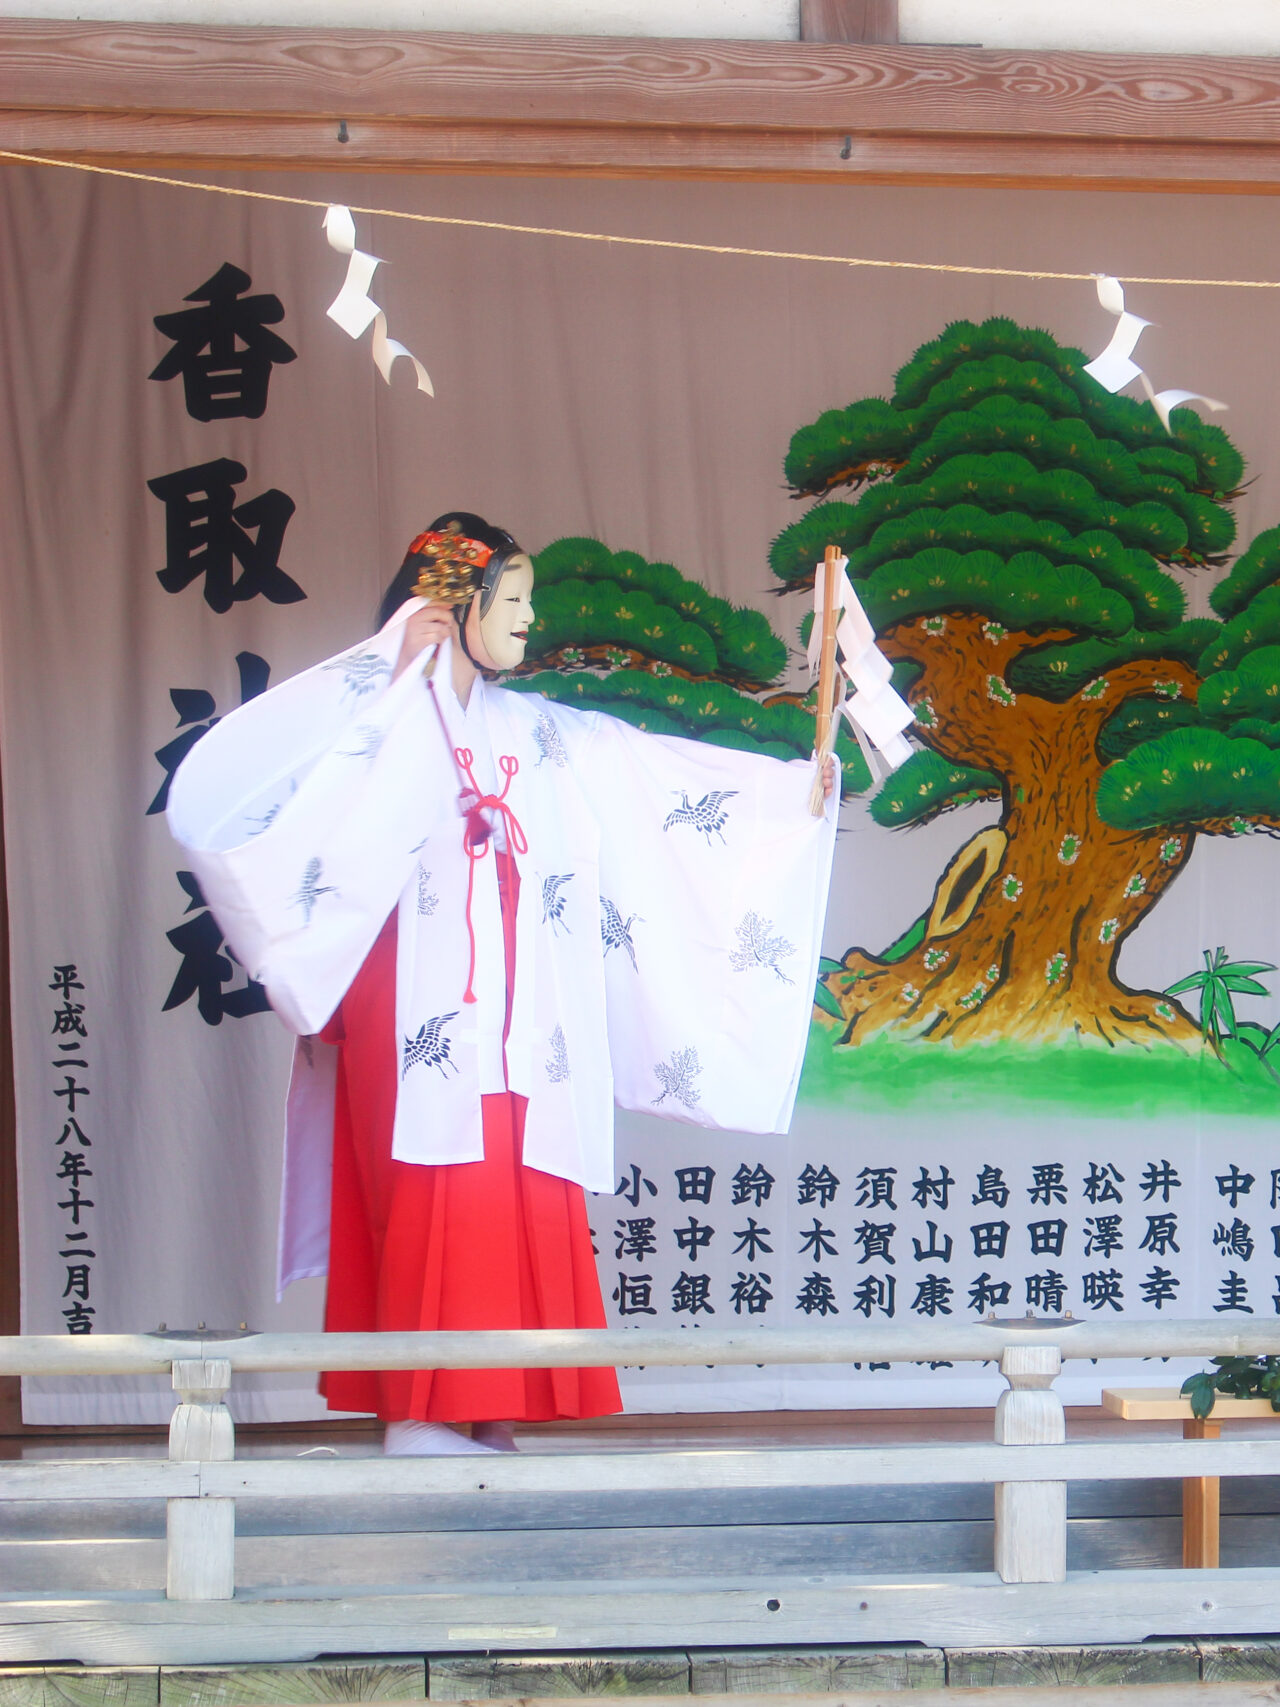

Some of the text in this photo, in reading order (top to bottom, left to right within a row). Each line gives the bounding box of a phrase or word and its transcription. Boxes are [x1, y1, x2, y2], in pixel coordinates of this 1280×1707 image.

[612, 1163, 659, 1371] 小澤恒
[671, 1165, 717, 1369] 田中銀
[729, 1162, 776, 1368] 鈴木裕
[967, 1163, 1012, 1367] 島田和
[1024, 1162, 1069, 1364] 栗田晴
[1082, 1161, 1126, 1365] 松澤暎
[1138, 1159, 1183, 1363] 井原幸
